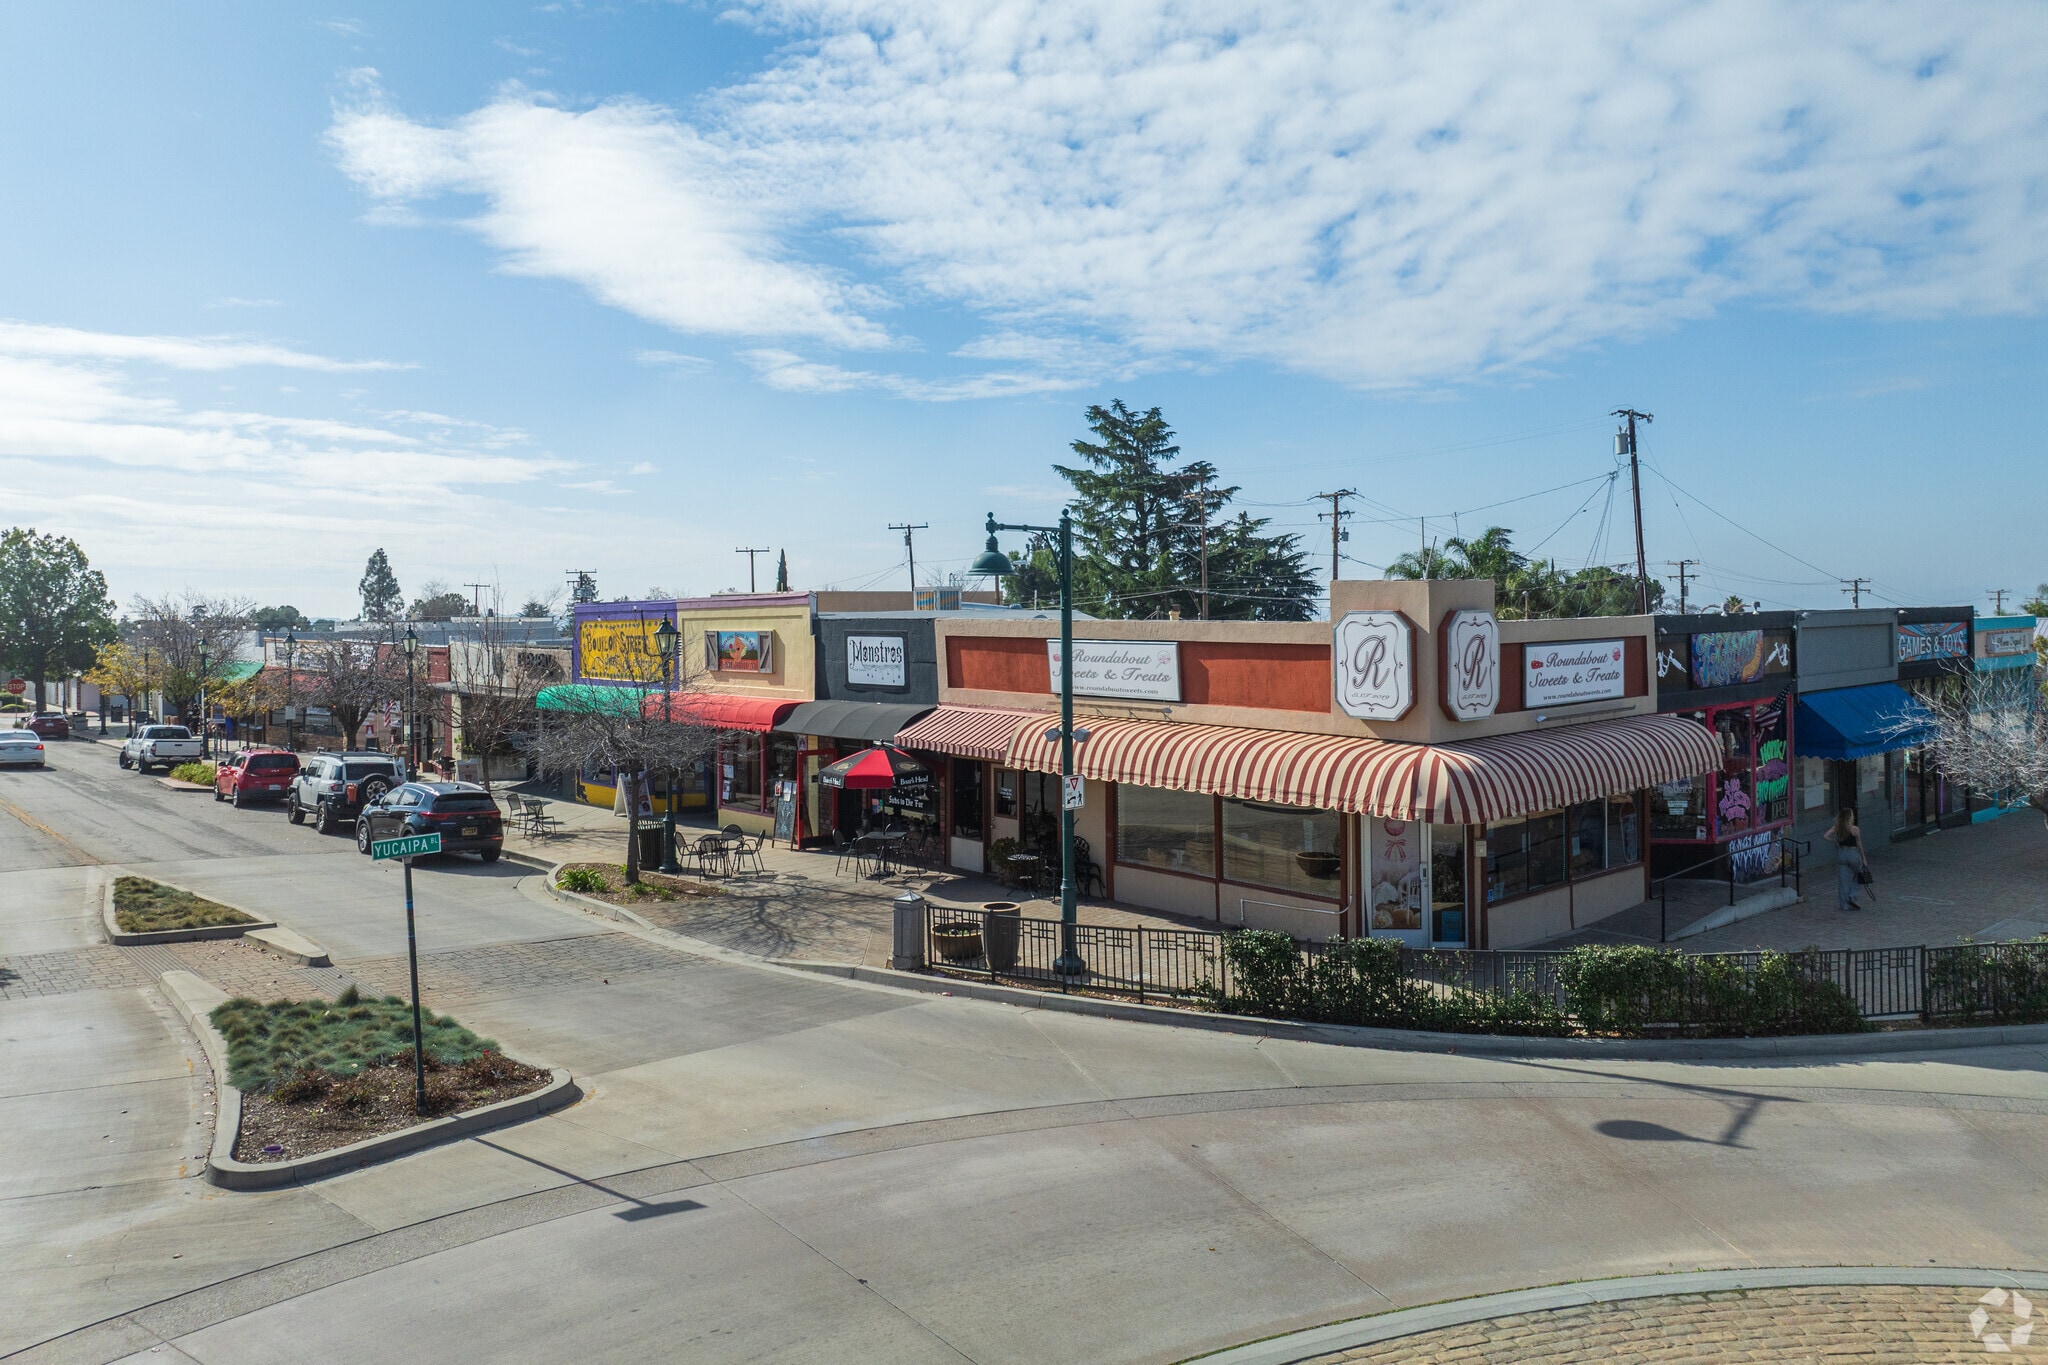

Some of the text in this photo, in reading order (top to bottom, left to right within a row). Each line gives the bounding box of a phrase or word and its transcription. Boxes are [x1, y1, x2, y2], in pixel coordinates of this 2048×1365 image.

[620, 631, 649, 655] STREET
[1899, 631, 1965, 660] GAMES & TOYS
[849, 639, 903, 669] Monstros
[1072, 648, 1152, 665] Roundabout
[1353, 634, 1391, 690] R
[1463, 634, 1488, 690] R
[1546, 650, 1608, 668] Roundabout
[1052, 666, 1171, 682] Seets & Treats
[1529, 667, 1620, 688] Sweets & Treats
[1543, 689, 1612, 701] www.roundaboutsweets.com
[914, 775, 928, 784] Head
[889, 796, 900, 805] Subs
[905, 797, 914, 806] Die
[914, 799, 924, 808] For
[375, 839, 428, 857] YUCAIPA
